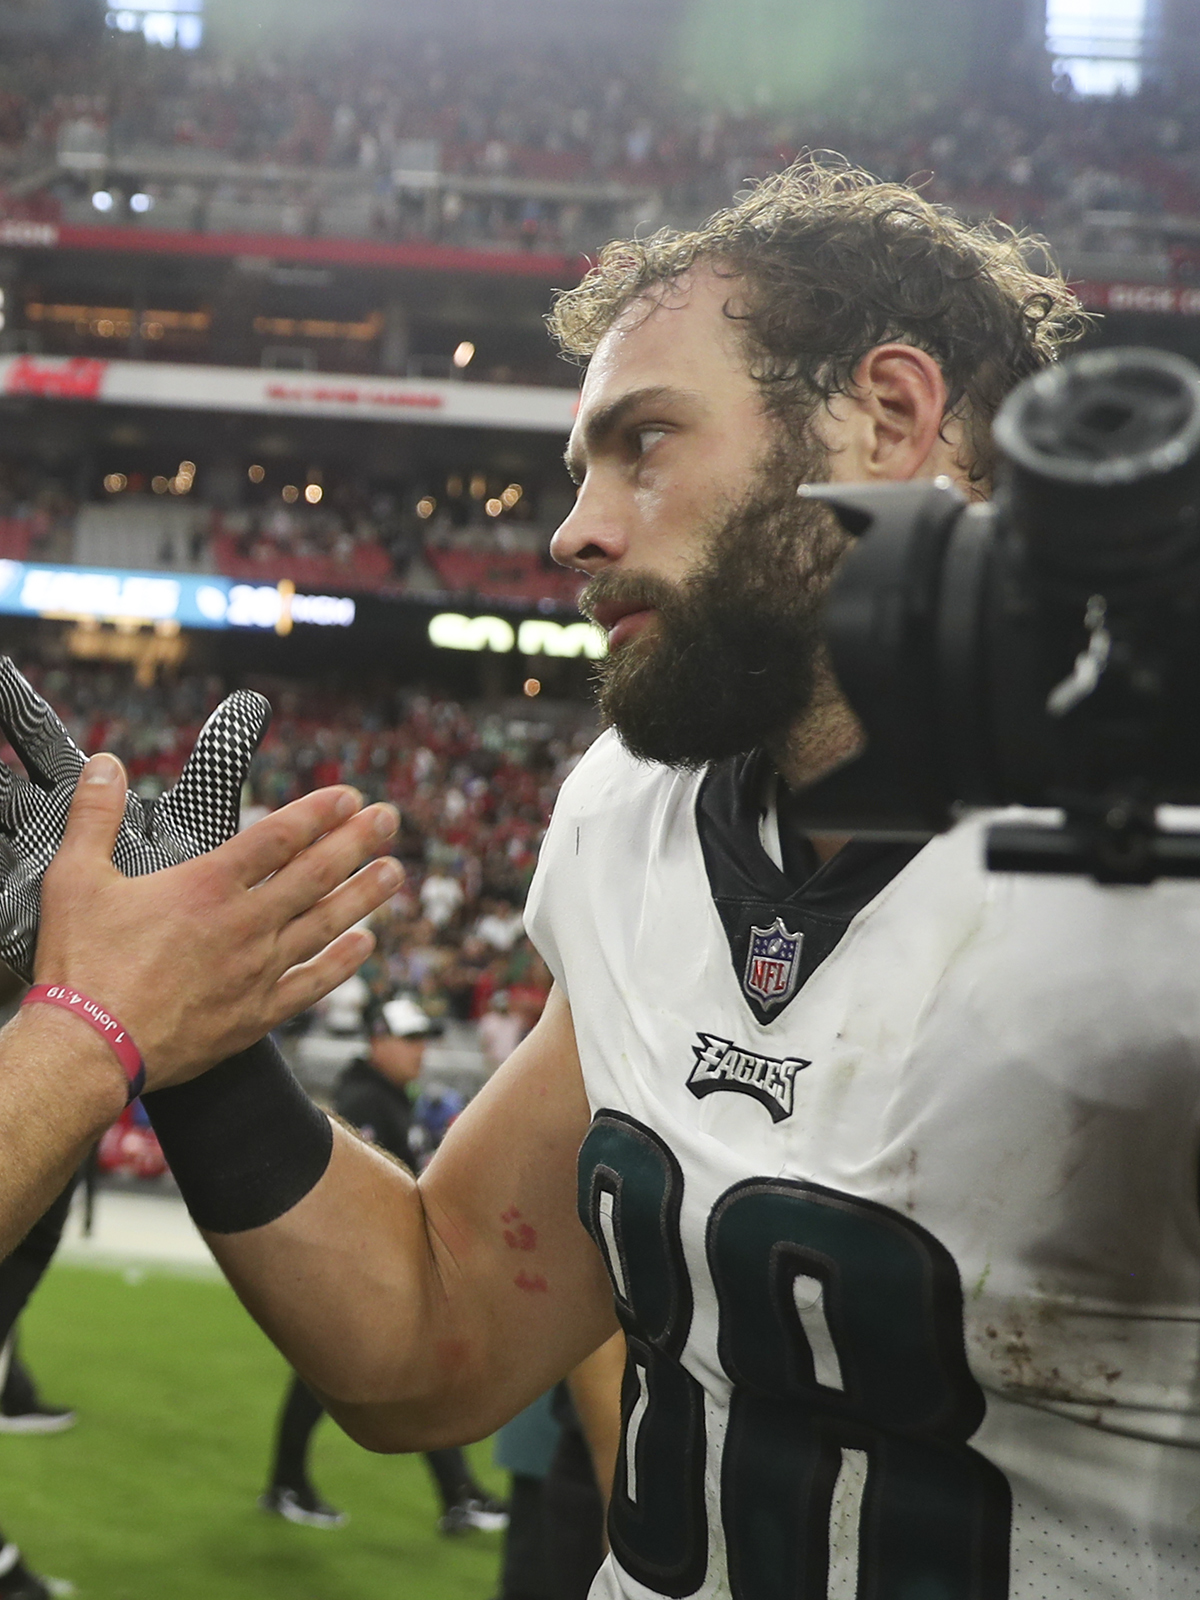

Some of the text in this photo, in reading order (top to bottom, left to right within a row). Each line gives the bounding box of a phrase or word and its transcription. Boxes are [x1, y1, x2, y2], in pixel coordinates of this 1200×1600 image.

[750, 958, 786, 995] NFL
[83, 1000, 118, 1031] John
[114, 1031, 126, 1043] 1
[688, 1034, 810, 1117] EAGLES
[578, 1107, 1013, 1600] 88
